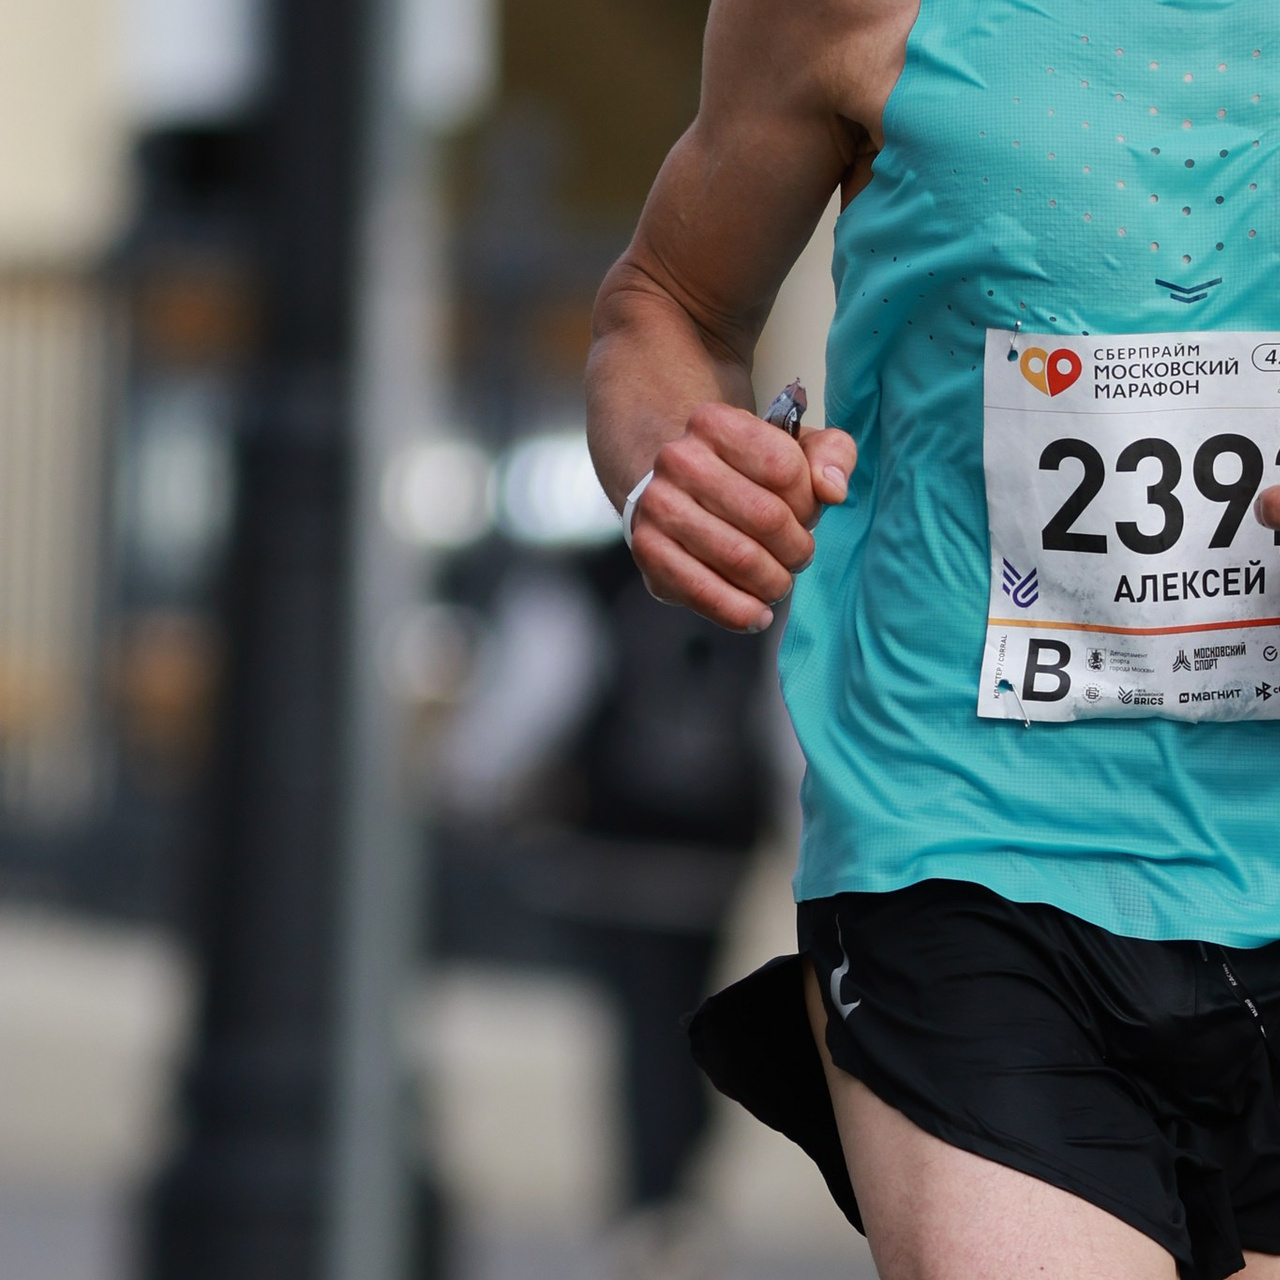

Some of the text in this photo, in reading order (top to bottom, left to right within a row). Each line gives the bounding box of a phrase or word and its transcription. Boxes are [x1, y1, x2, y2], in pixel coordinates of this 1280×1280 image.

[1094, 342, 1200, 361] СБЕРПРАЙМ
[1094, 357, 1239, 380] МОСКОВСКИЙ
[1094, 380, 1199, 399] МАРАФОН
[1114, 560, 1266, 603] АЛЕКСЕЙ
[1193, 642, 1246, 659] МОСКОВСКИЙ
[1194, 659, 1218, 671] СПОРТ
[1134, 697, 1164, 706] BRICS
